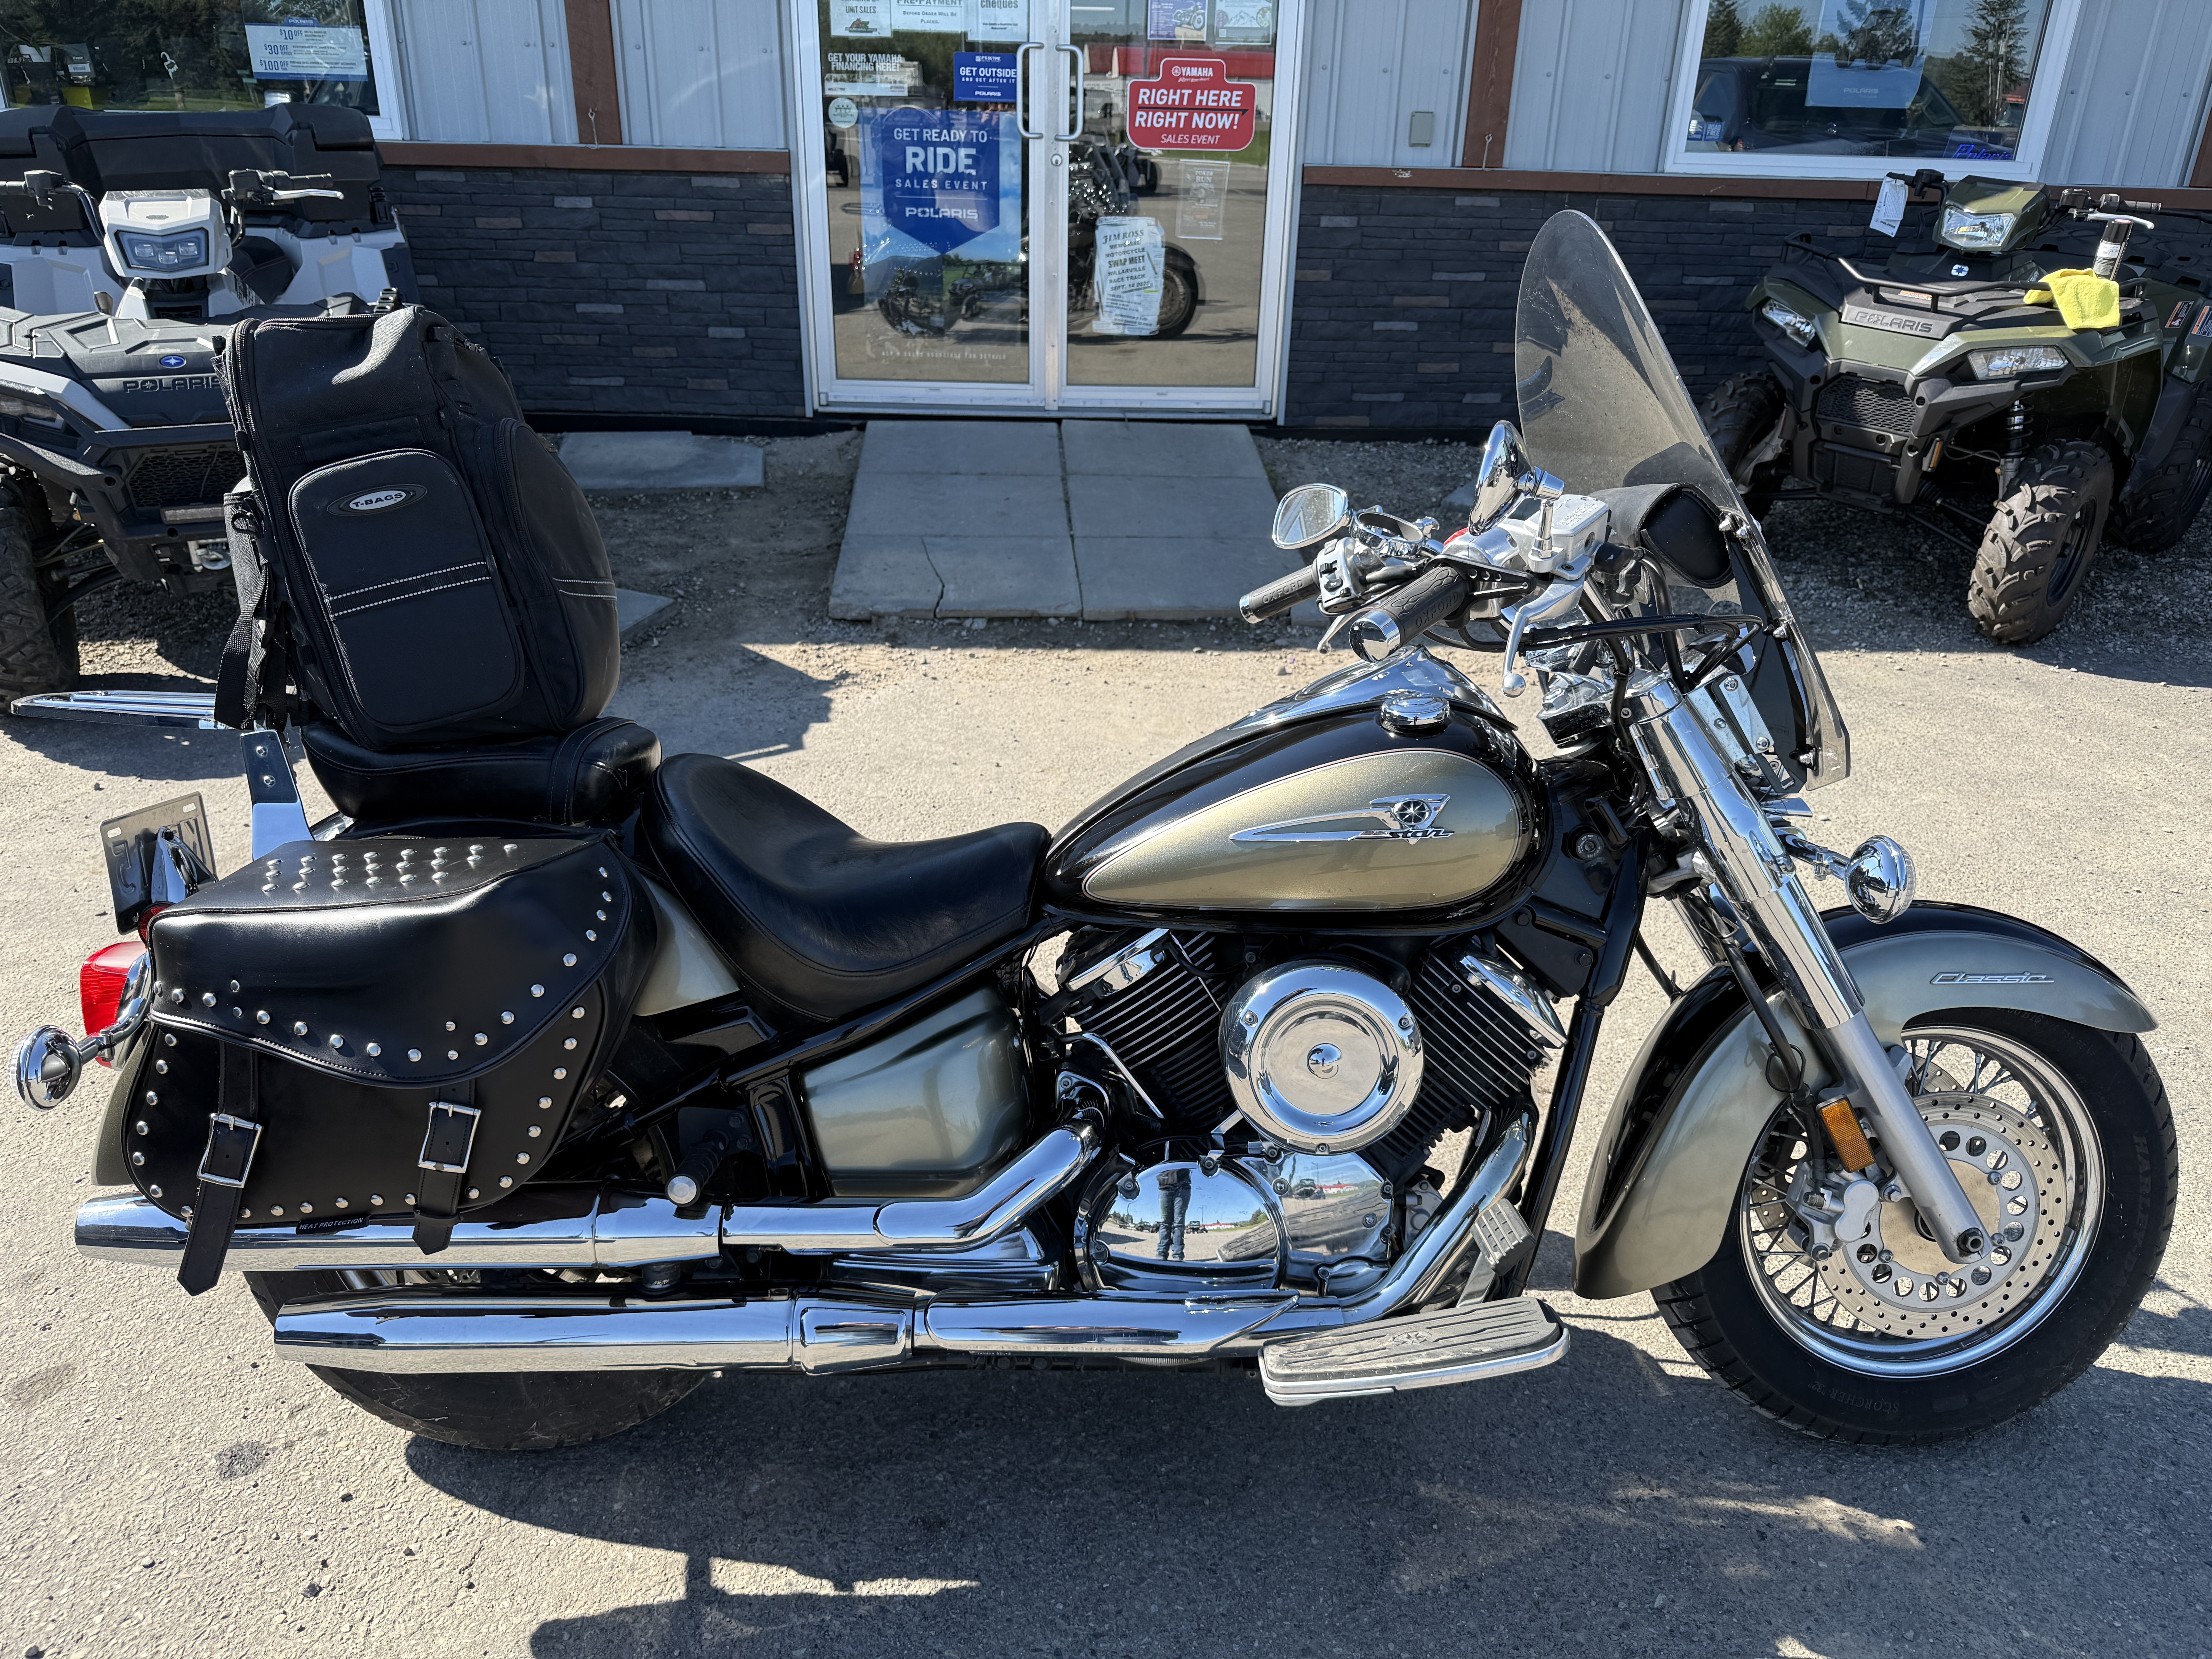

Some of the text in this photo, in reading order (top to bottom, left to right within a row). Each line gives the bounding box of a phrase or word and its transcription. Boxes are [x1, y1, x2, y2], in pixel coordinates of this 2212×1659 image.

[280, 29, 294, 40] $10
[264, 44, 279, 55] $30
[828, 53, 902, 63] GET YOUR YAMAHA
[260, 59, 279, 70] $100
[831, 62, 899, 71] FINANCING HERE!
[960, 67, 1017, 77] GET OUTSIDE
[1181, 67, 1213, 77] YAMAHA
[1138, 88, 1243, 106] RIGHT HERE
[1135, 112, 1239, 129] RIGHT NOW!
[894, 128, 987, 143] GET READY TO
[1161, 134, 1220, 144] SALES EVENT
[905, 146, 977, 176] RIDE
[895, 179, 988, 190] SALES EVENT
[905, 207, 978, 219] POLARIS
[1102, 229, 1144, 244] JIM ROSS
[1128, 255, 1145, 265] MEET
[1855, 311, 1933, 333] POLARIS
[352, 493, 403, 507] T-BAGS
[1262, 580, 1304, 603] OXFORD
[1415, 591, 1458, 628] OXFORD
[1930, 971, 2054, 984] Classic
[319, 1218, 364, 1228] PROTECTION
[1829, 1388, 1900, 1413] SCORCHER
